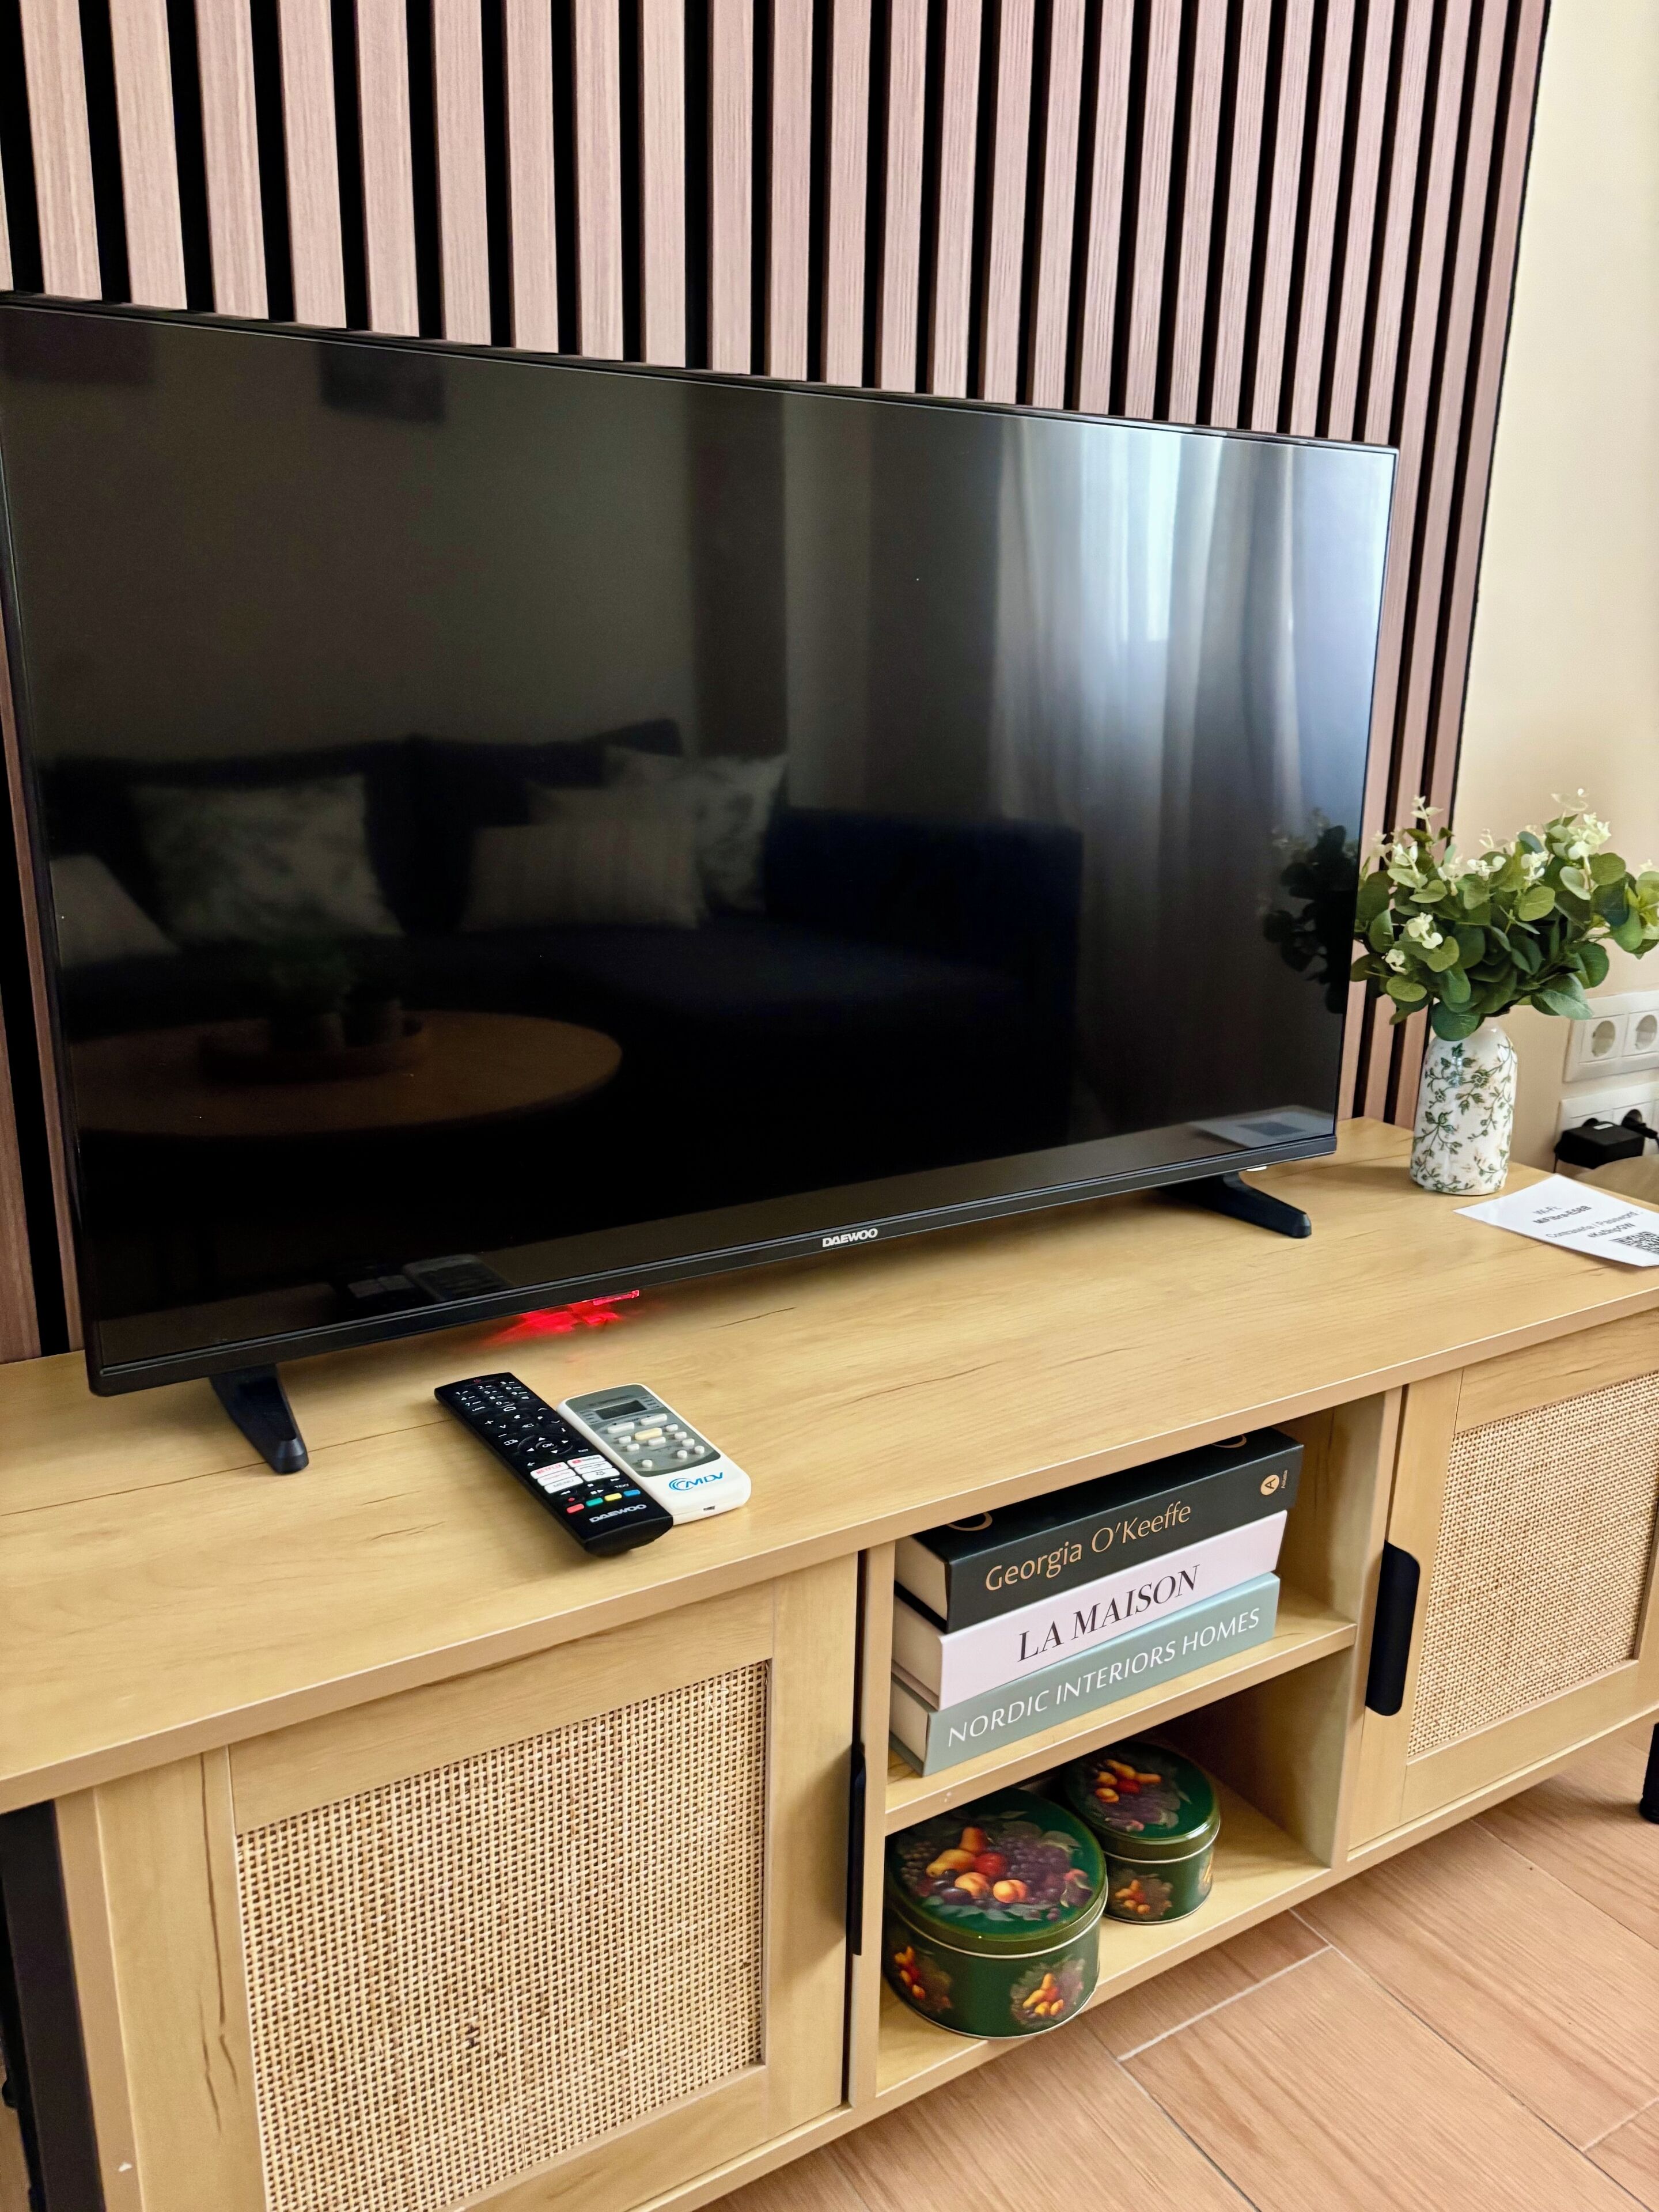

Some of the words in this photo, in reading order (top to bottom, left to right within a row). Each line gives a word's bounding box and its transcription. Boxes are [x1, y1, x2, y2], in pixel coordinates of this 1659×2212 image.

[822, 1228, 878, 1248] DAEWOO
[536, 1464, 563, 1475] NETFLIX
[589, 1504, 647, 1523] DAEWOO
[985, 1541, 1082, 1592] Georgia
[1090, 1501, 1192, 1553] O'Keeffe
[1016, 1620, 1064, 1662] LA
[1071, 1564, 1201, 1640] MAISON
[948, 1690, 1050, 1747] NORDIC
[1055, 1640, 1176, 1705] INTERIORS
[1181, 1607, 1260, 1656] HOMES
